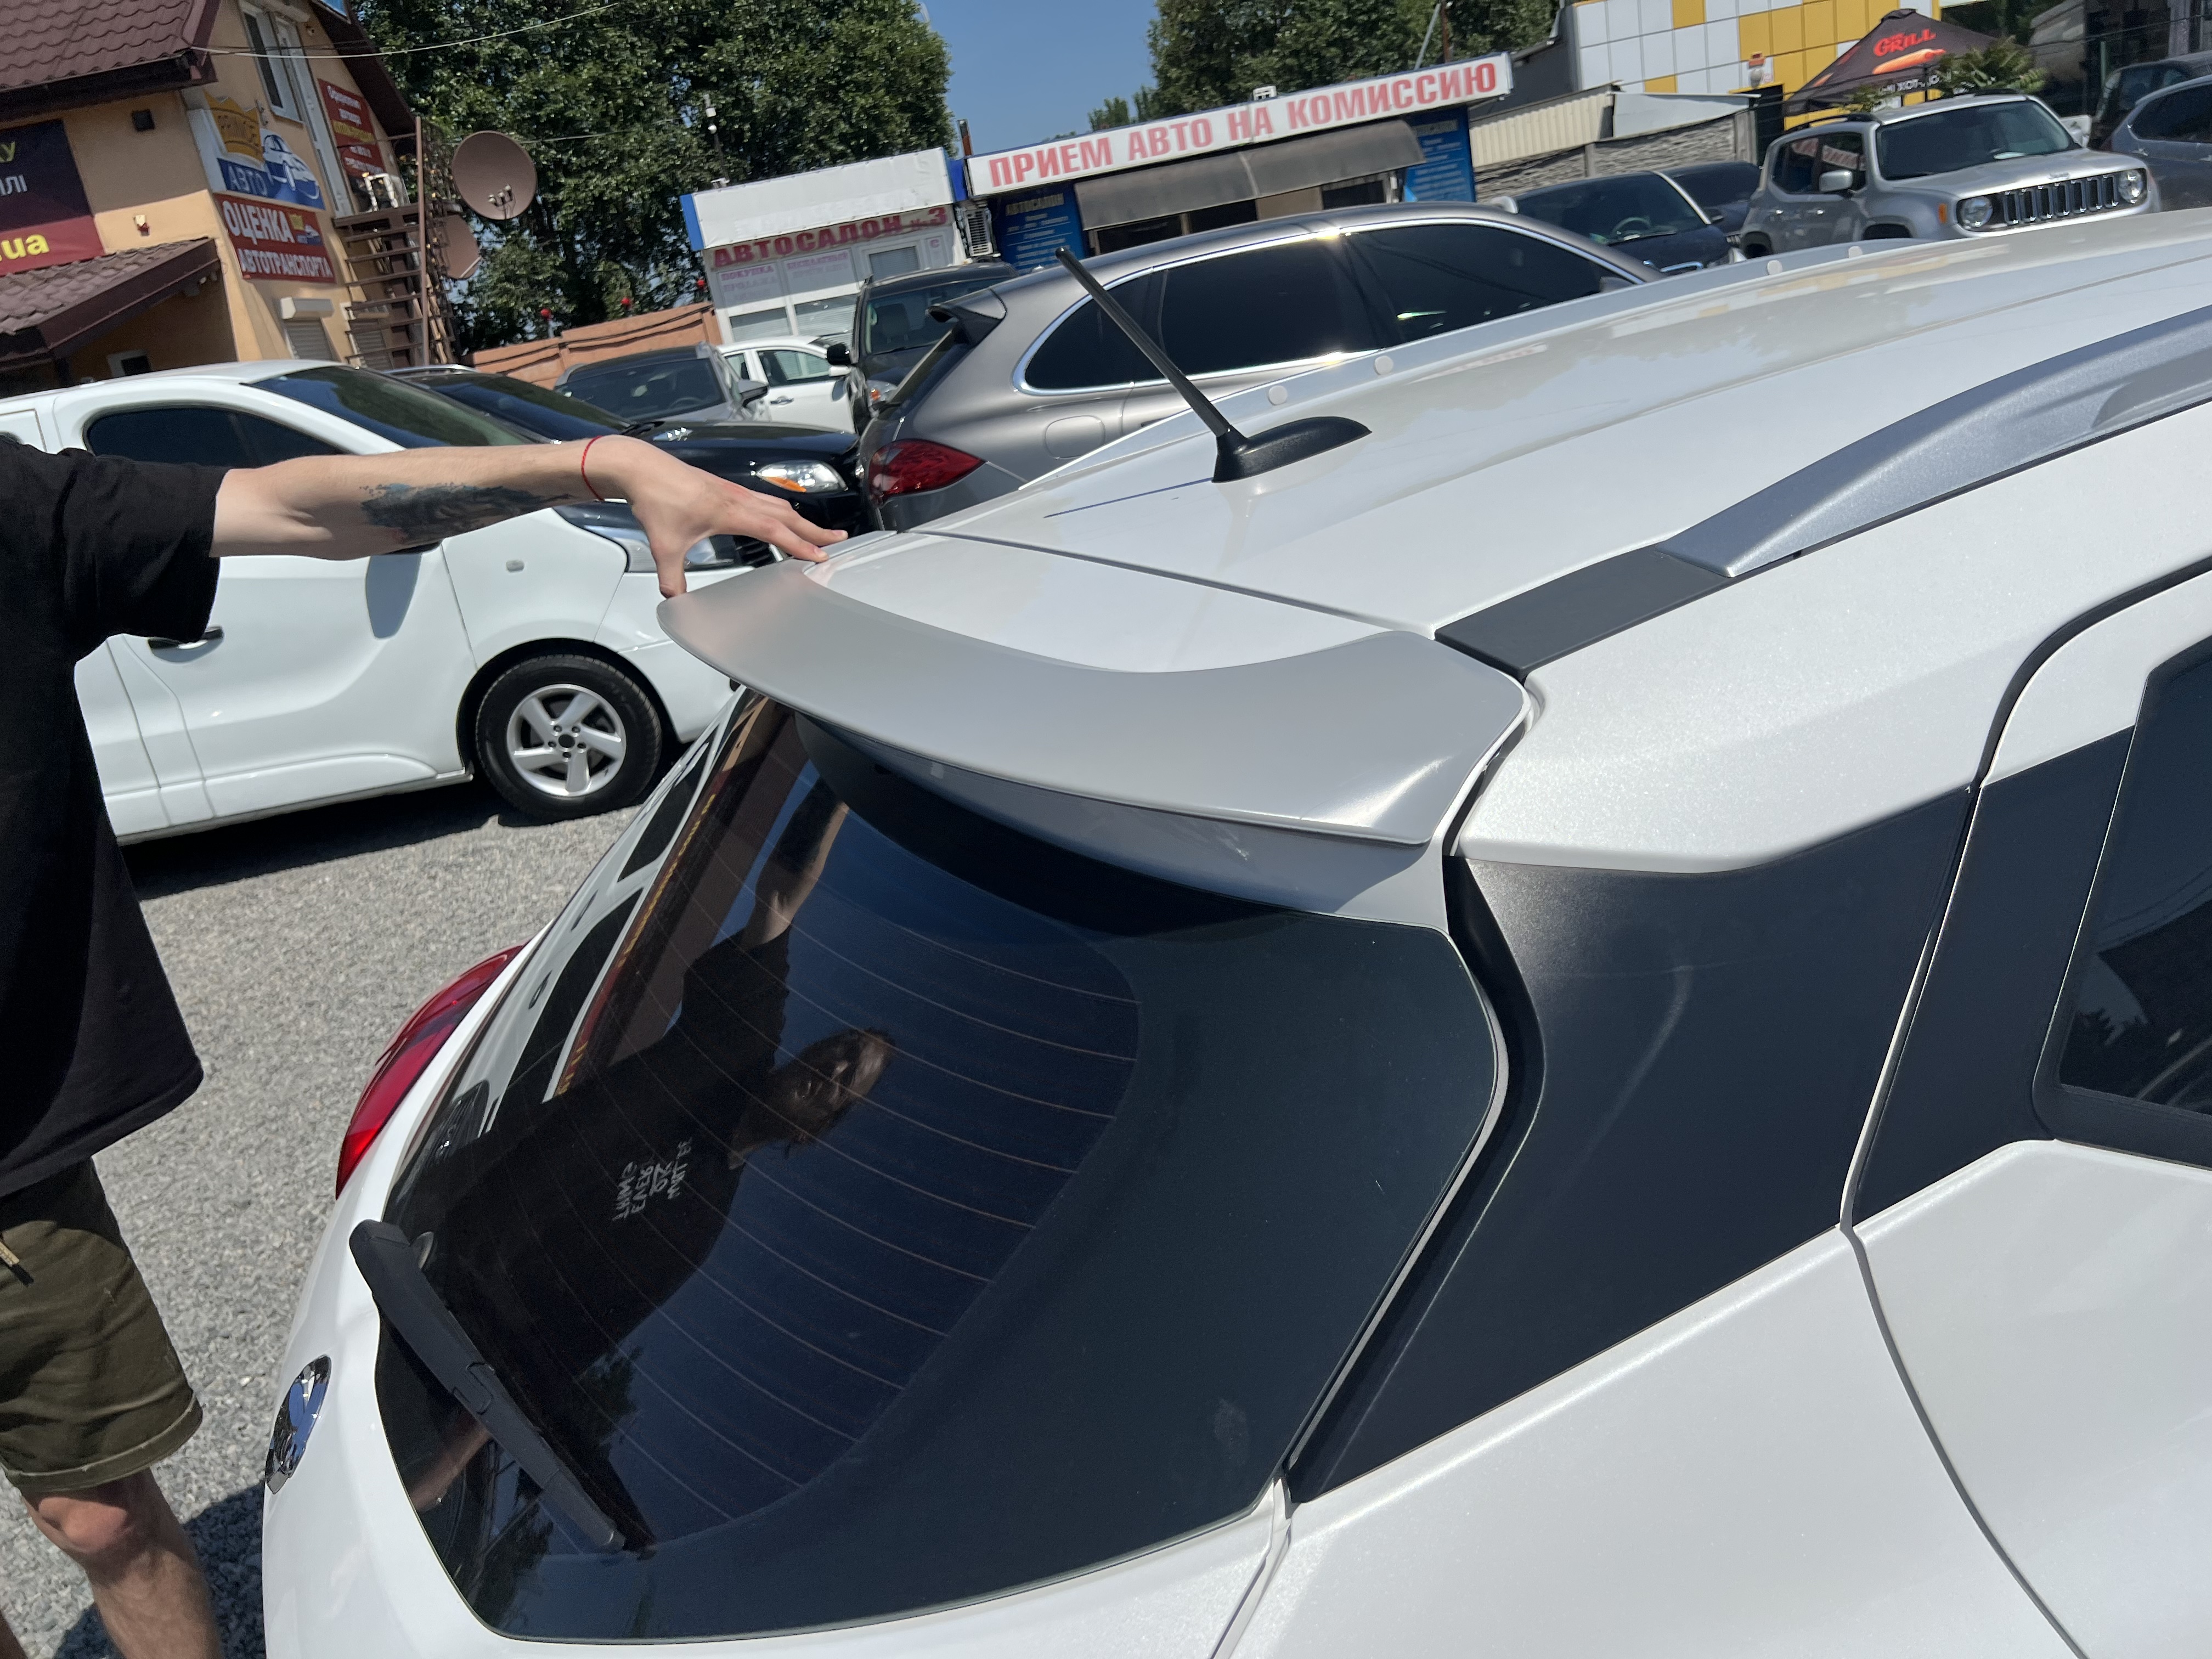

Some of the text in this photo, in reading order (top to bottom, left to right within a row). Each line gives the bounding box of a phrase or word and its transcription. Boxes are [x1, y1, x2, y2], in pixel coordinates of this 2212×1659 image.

[989, 63, 1497, 187] ПРИЕМ АВТО НА КОМИССИЮ
[228, 166, 268, 196] АВТО
[223, 200, 295, 245] ОЦЕНКА
[715, 215, 903, 267] АВТОСАЛОН
[238, 249, 334, 278] АВТОТРАНСПОРТА
